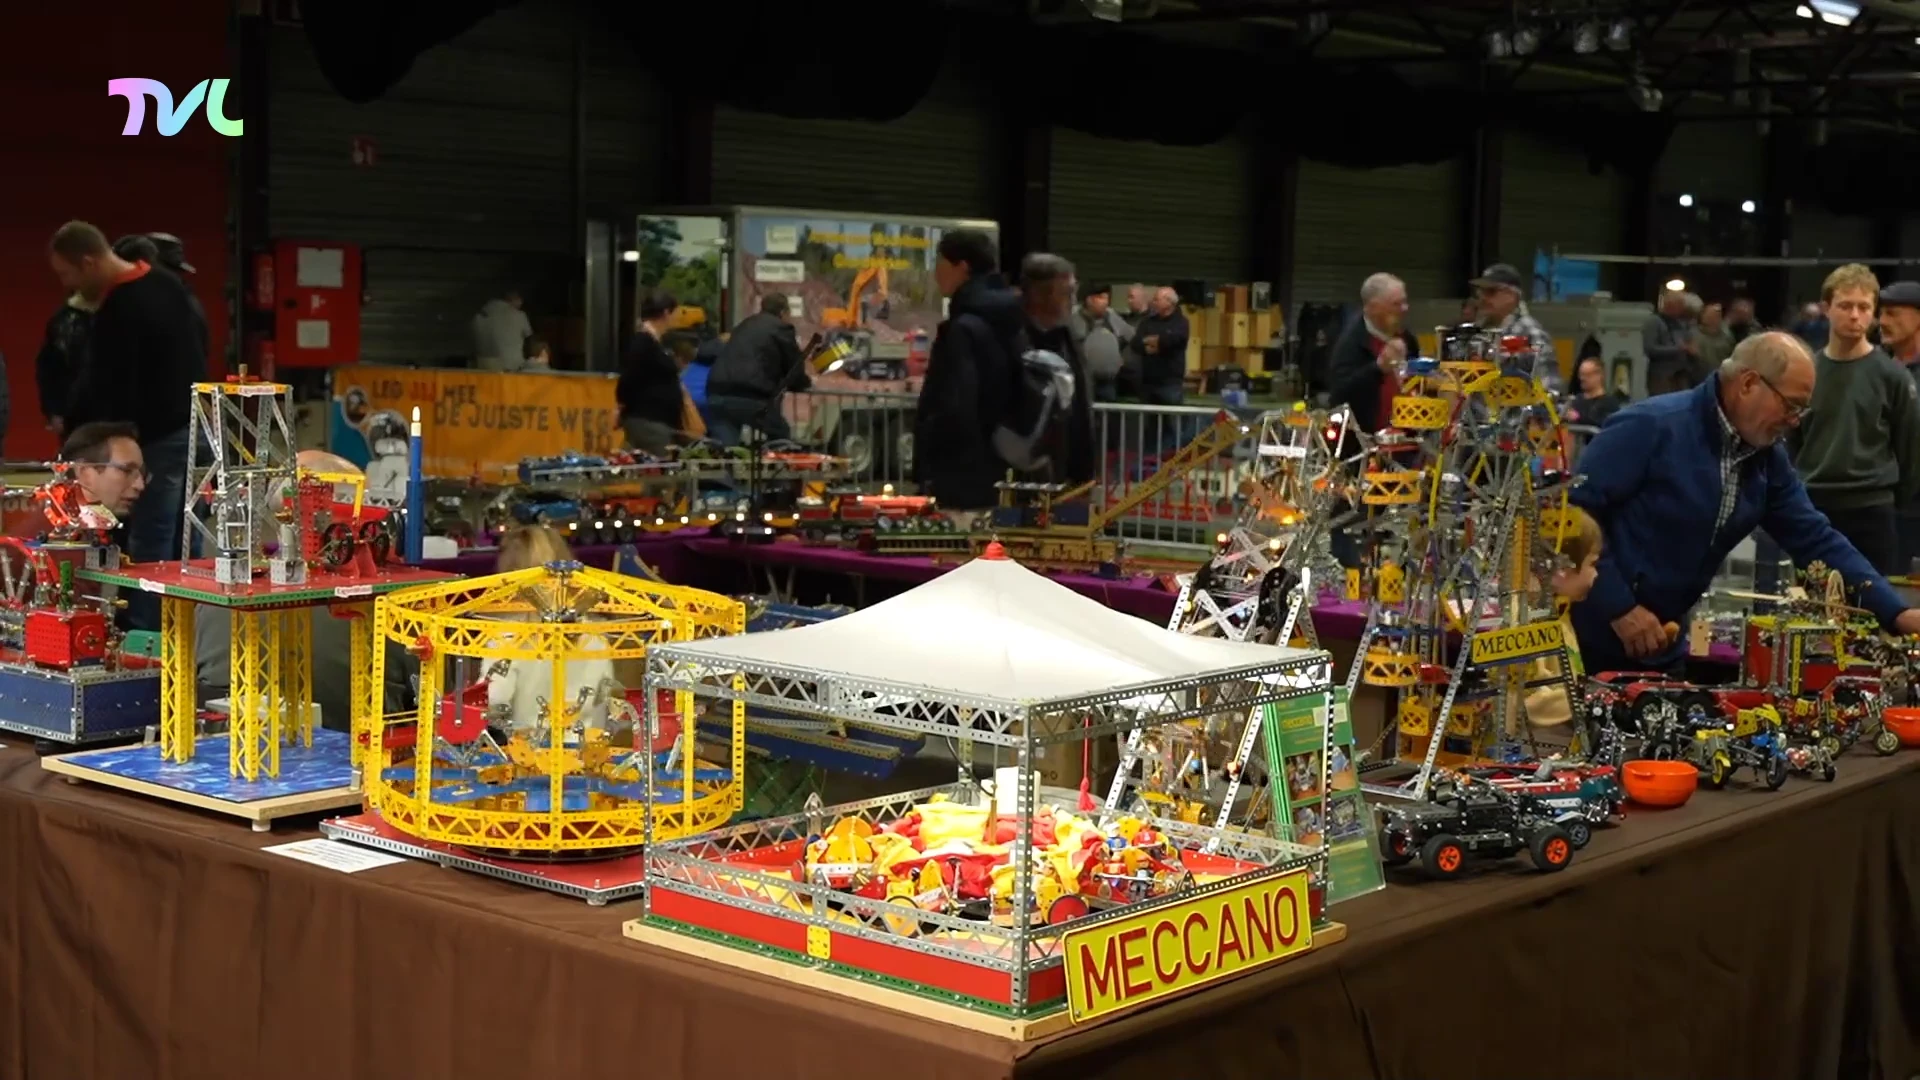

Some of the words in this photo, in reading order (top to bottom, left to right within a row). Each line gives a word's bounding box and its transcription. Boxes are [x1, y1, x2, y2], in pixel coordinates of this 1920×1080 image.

[433, 402, 460, 428] DE
[467, 403, 549, 432] JUISTE
[1476, 626, 1560, 657] MECCANO
[1080, 886, 1299, 1011] MECCANO
